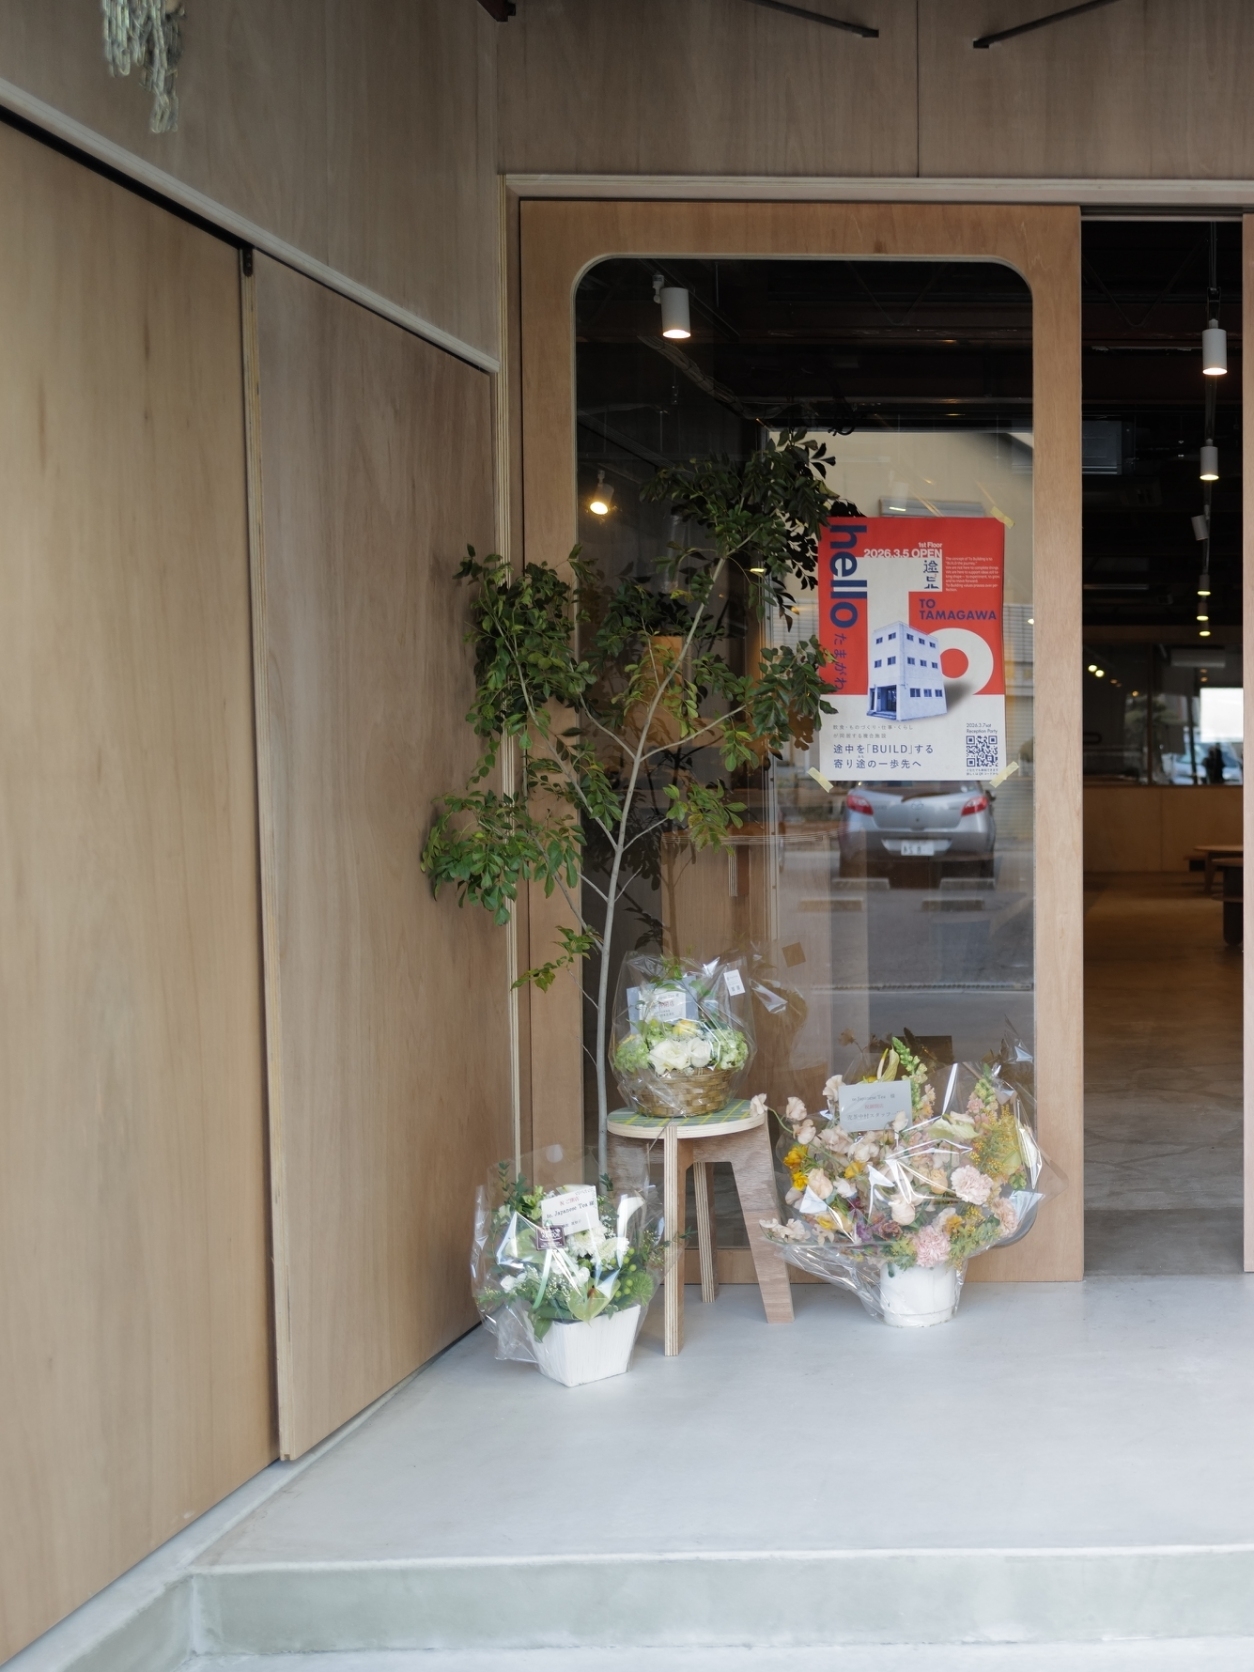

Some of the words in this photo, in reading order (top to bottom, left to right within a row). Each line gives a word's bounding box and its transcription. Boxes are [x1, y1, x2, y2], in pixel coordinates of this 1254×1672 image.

[864, 549, 910, 558] 2026.3.5
[911, 549, 943, 558] OPEN
[829, 525, 868, 629] hello
[919, 598, 936, 609] TO
[919, 610, 997, 620] TAMAGAWA
[833, 633, 847, 690] たまがわ
[833, 744, 934, 755] 途中を「BUILD」する
[833, 759, 922, 769] 寄り途の一歩先へ
